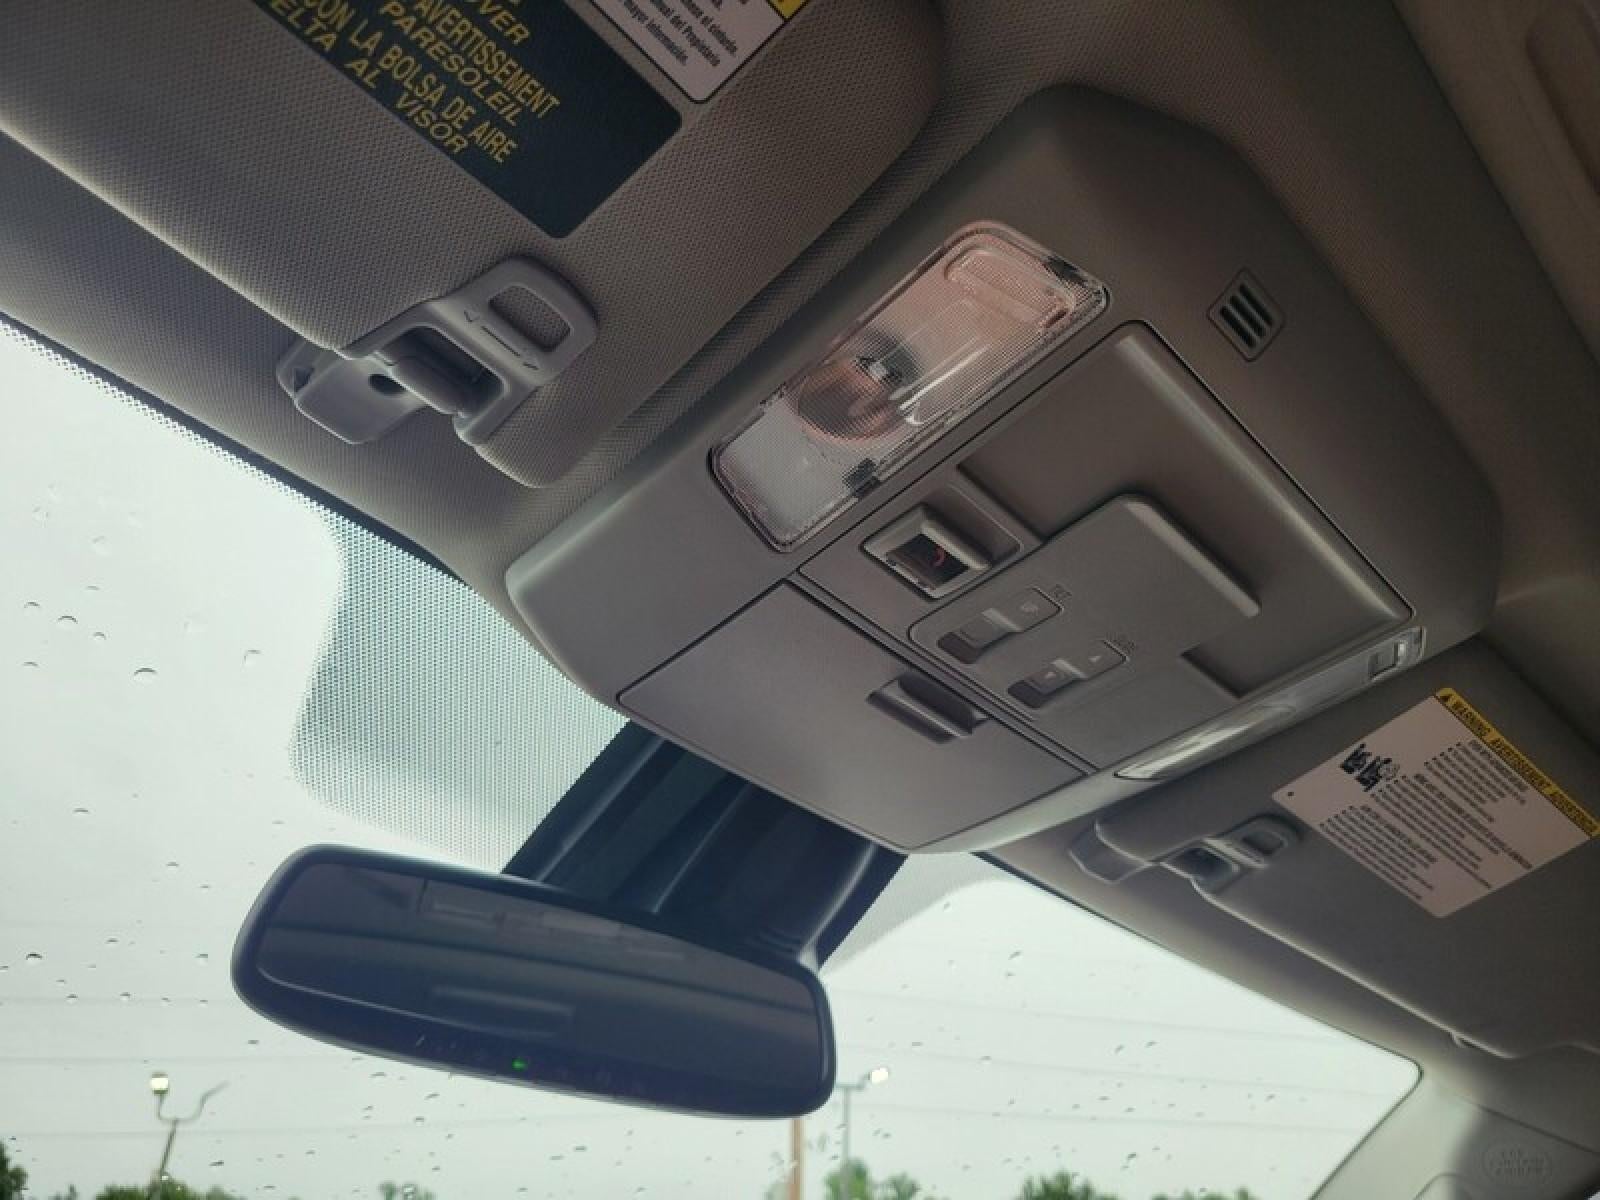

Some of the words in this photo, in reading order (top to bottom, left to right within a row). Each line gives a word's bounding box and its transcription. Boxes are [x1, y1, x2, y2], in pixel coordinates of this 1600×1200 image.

[380, 0, 523, 126] PARESOLEIL
[414, 0, 561, 118] AVERTISSEMENT
[464, 0, 529, 44] VER
[344, 58, 380, 89] AL
[395, 91, 469, 154] VISOR
[349, 18, 384, 57] LA
[379, 44, 447, 106] BOLSA
[442, 96, 477, 129] DE
[469, 120, 518, 163] AIRE
